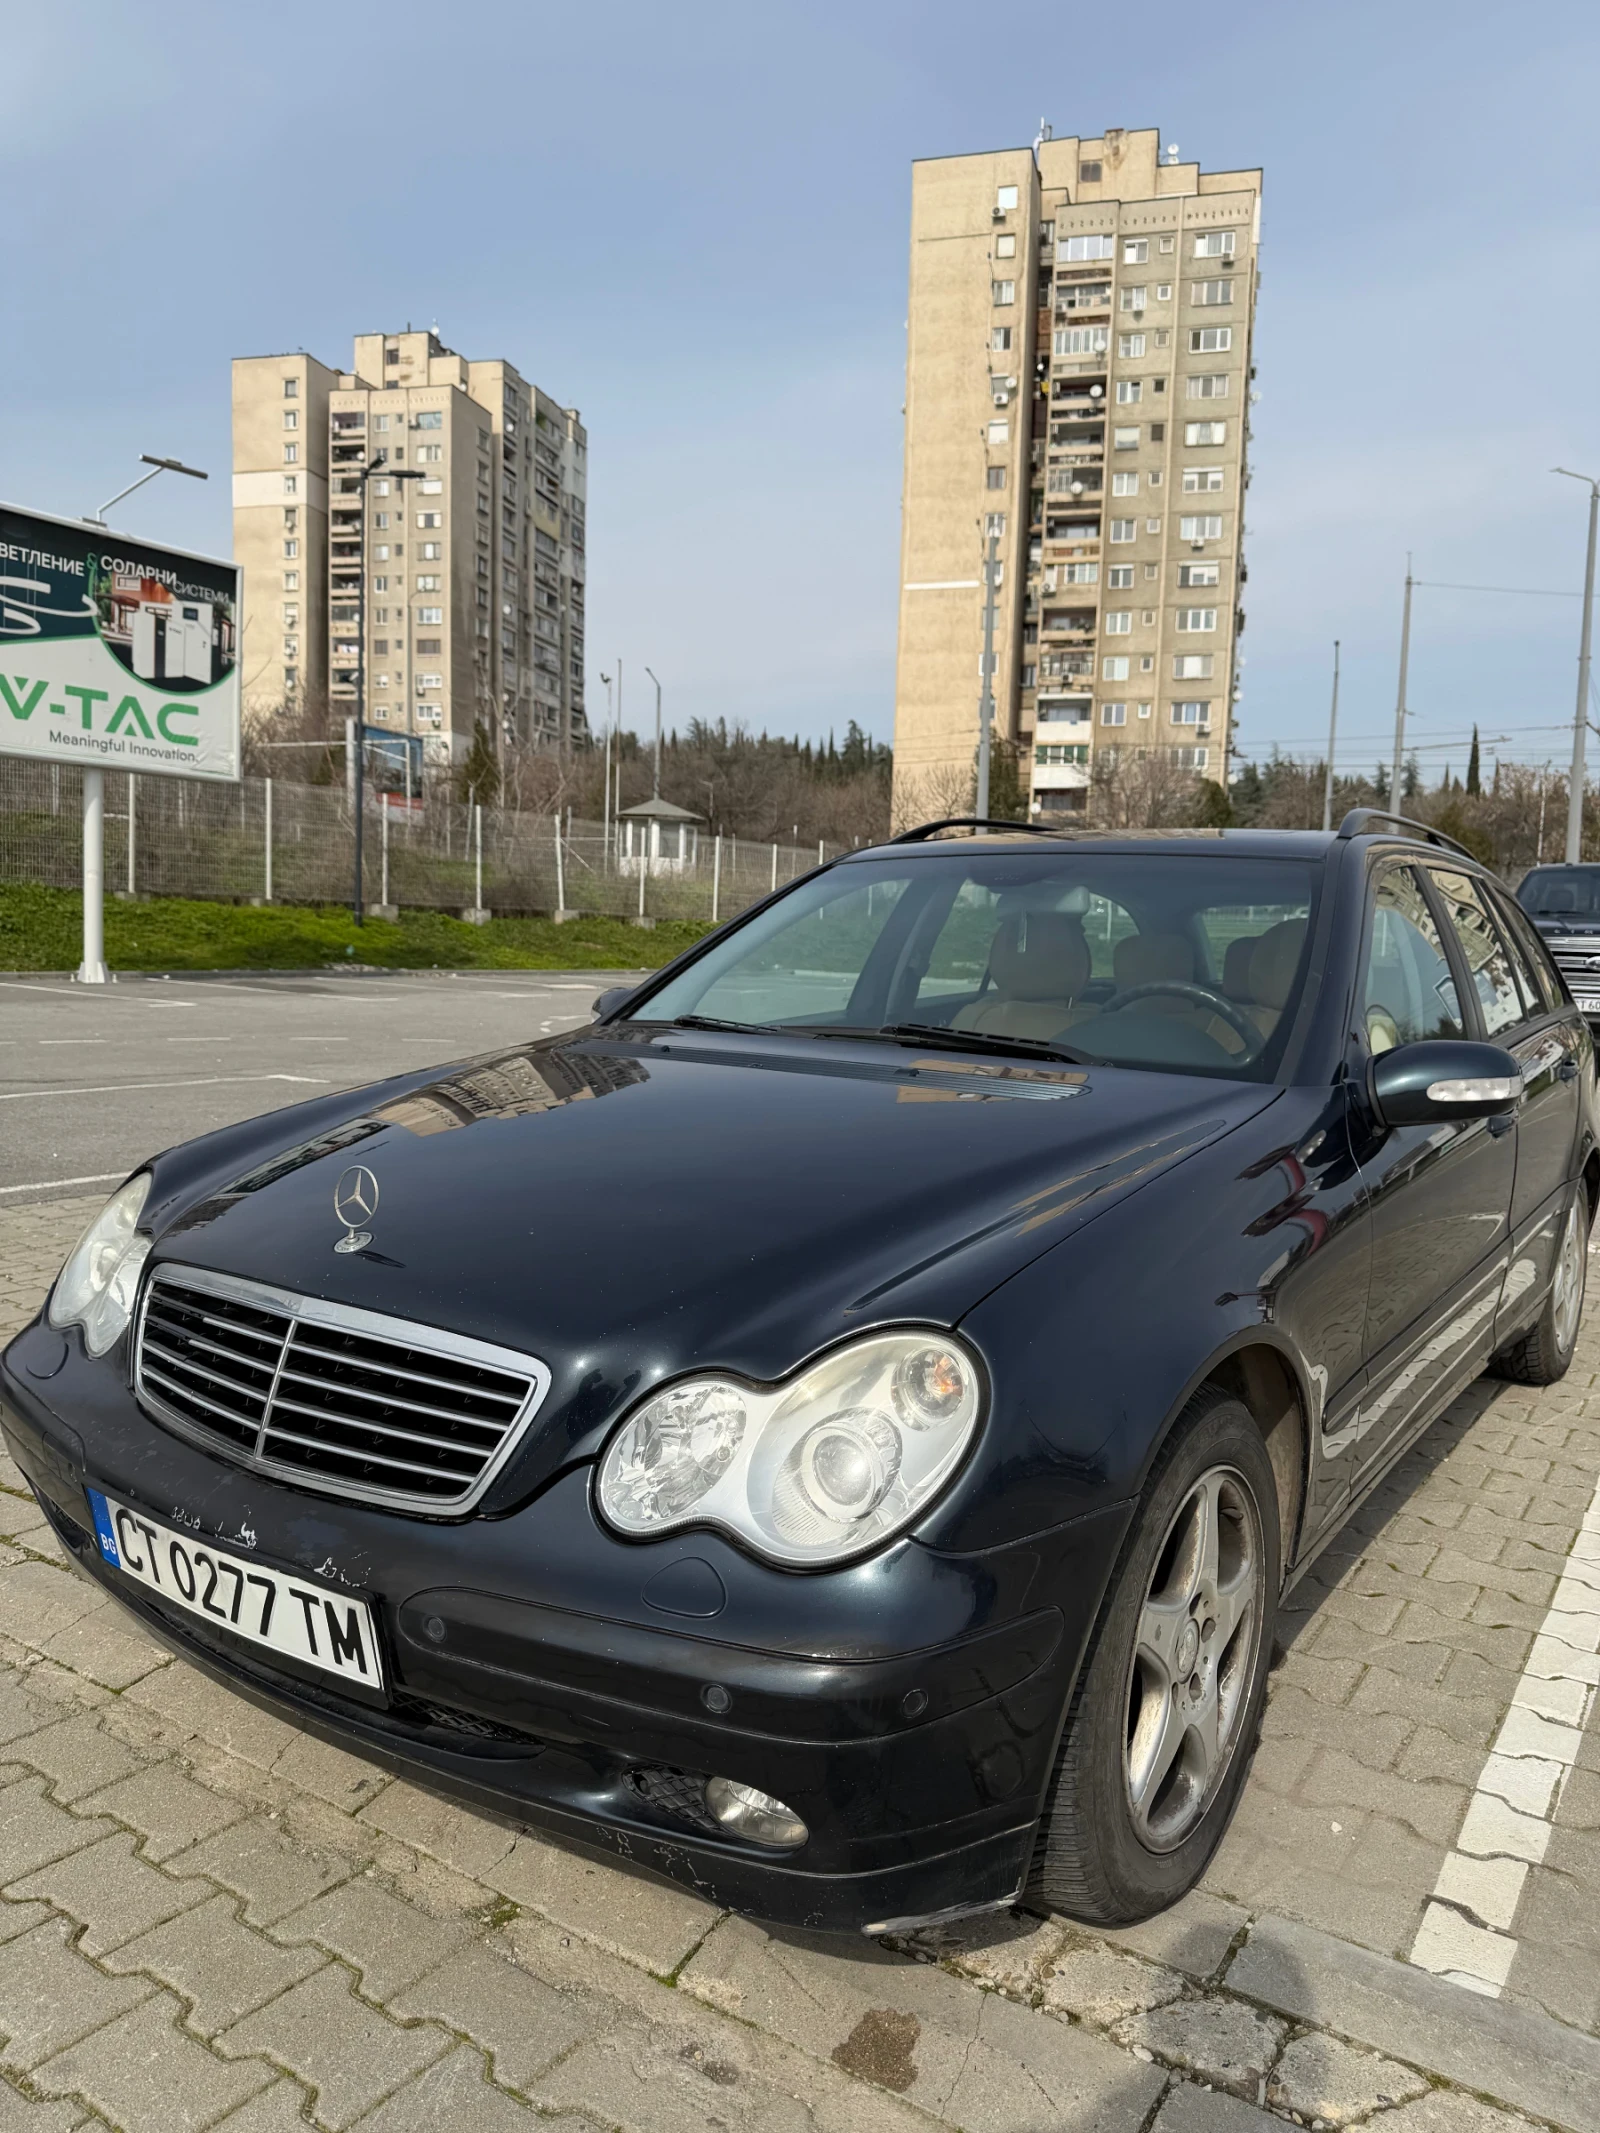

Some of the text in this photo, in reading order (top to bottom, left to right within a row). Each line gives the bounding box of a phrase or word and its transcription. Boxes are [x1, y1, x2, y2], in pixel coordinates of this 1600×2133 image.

[100, 555, 177, 585] СОЛАРНИ
[173, 581, 230, 603] СИСТЕМИ
[0, 673, 199, 746] V-TAC
[49, 730, 125, 753] Meaningful
[100, 1533, 117, 1555] BG
[115, 1508, 370, 1676] CT 0277 TM
